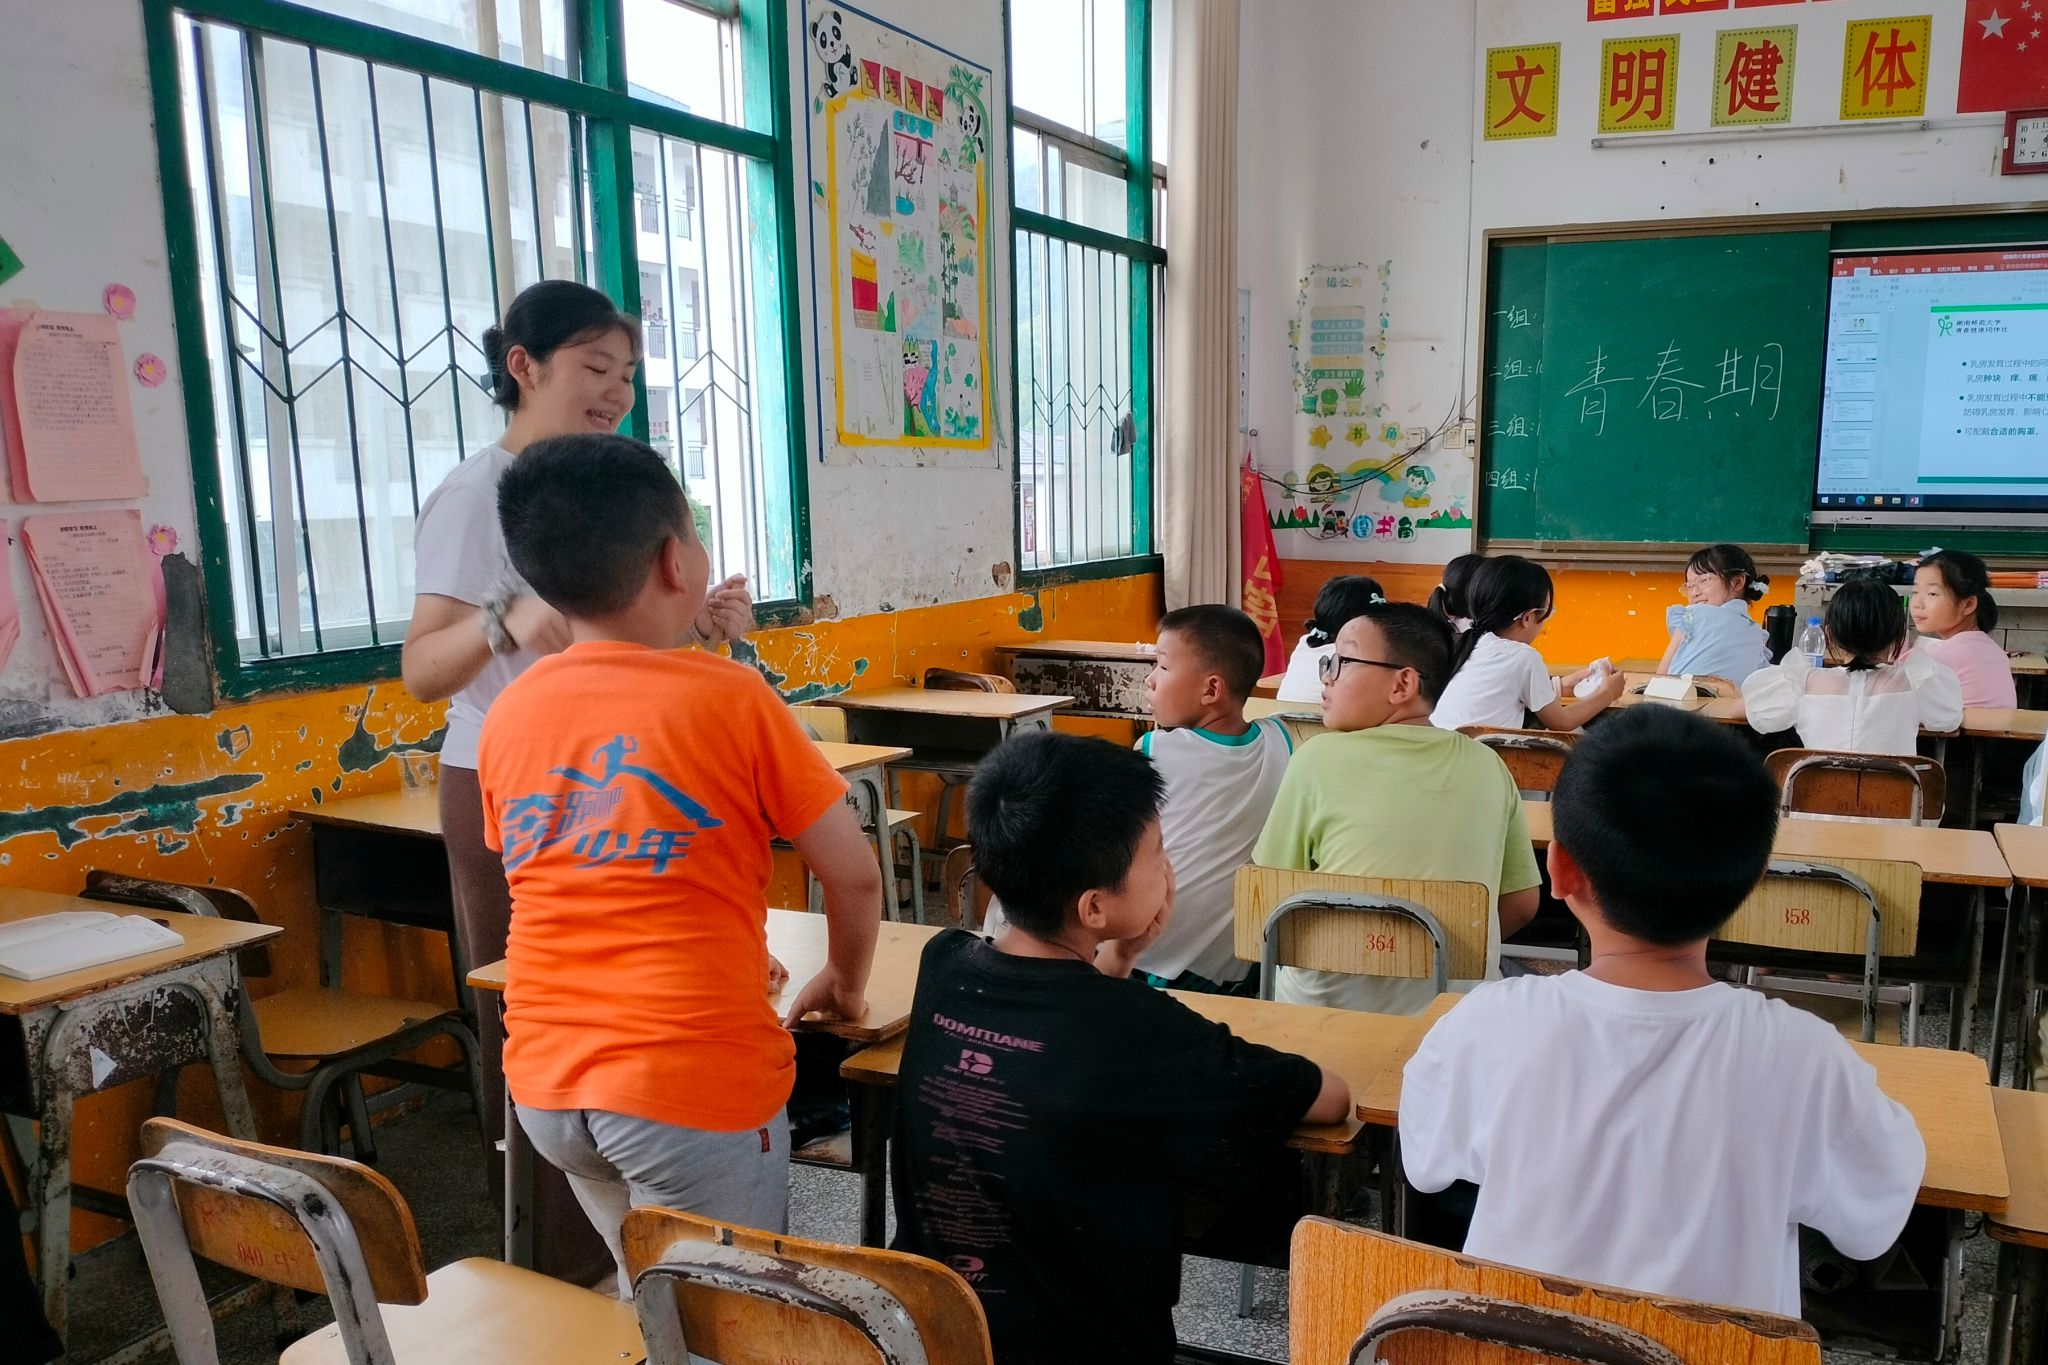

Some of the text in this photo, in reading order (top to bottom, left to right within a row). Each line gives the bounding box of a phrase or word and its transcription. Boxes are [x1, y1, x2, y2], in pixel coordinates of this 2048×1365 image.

[1564, 338, 1784, 436] 青春期
[1352, 513, 1414, 539] 图书角
[572, 828, 696, 875] 少年
[1366, 932, 1396, 953] 364
